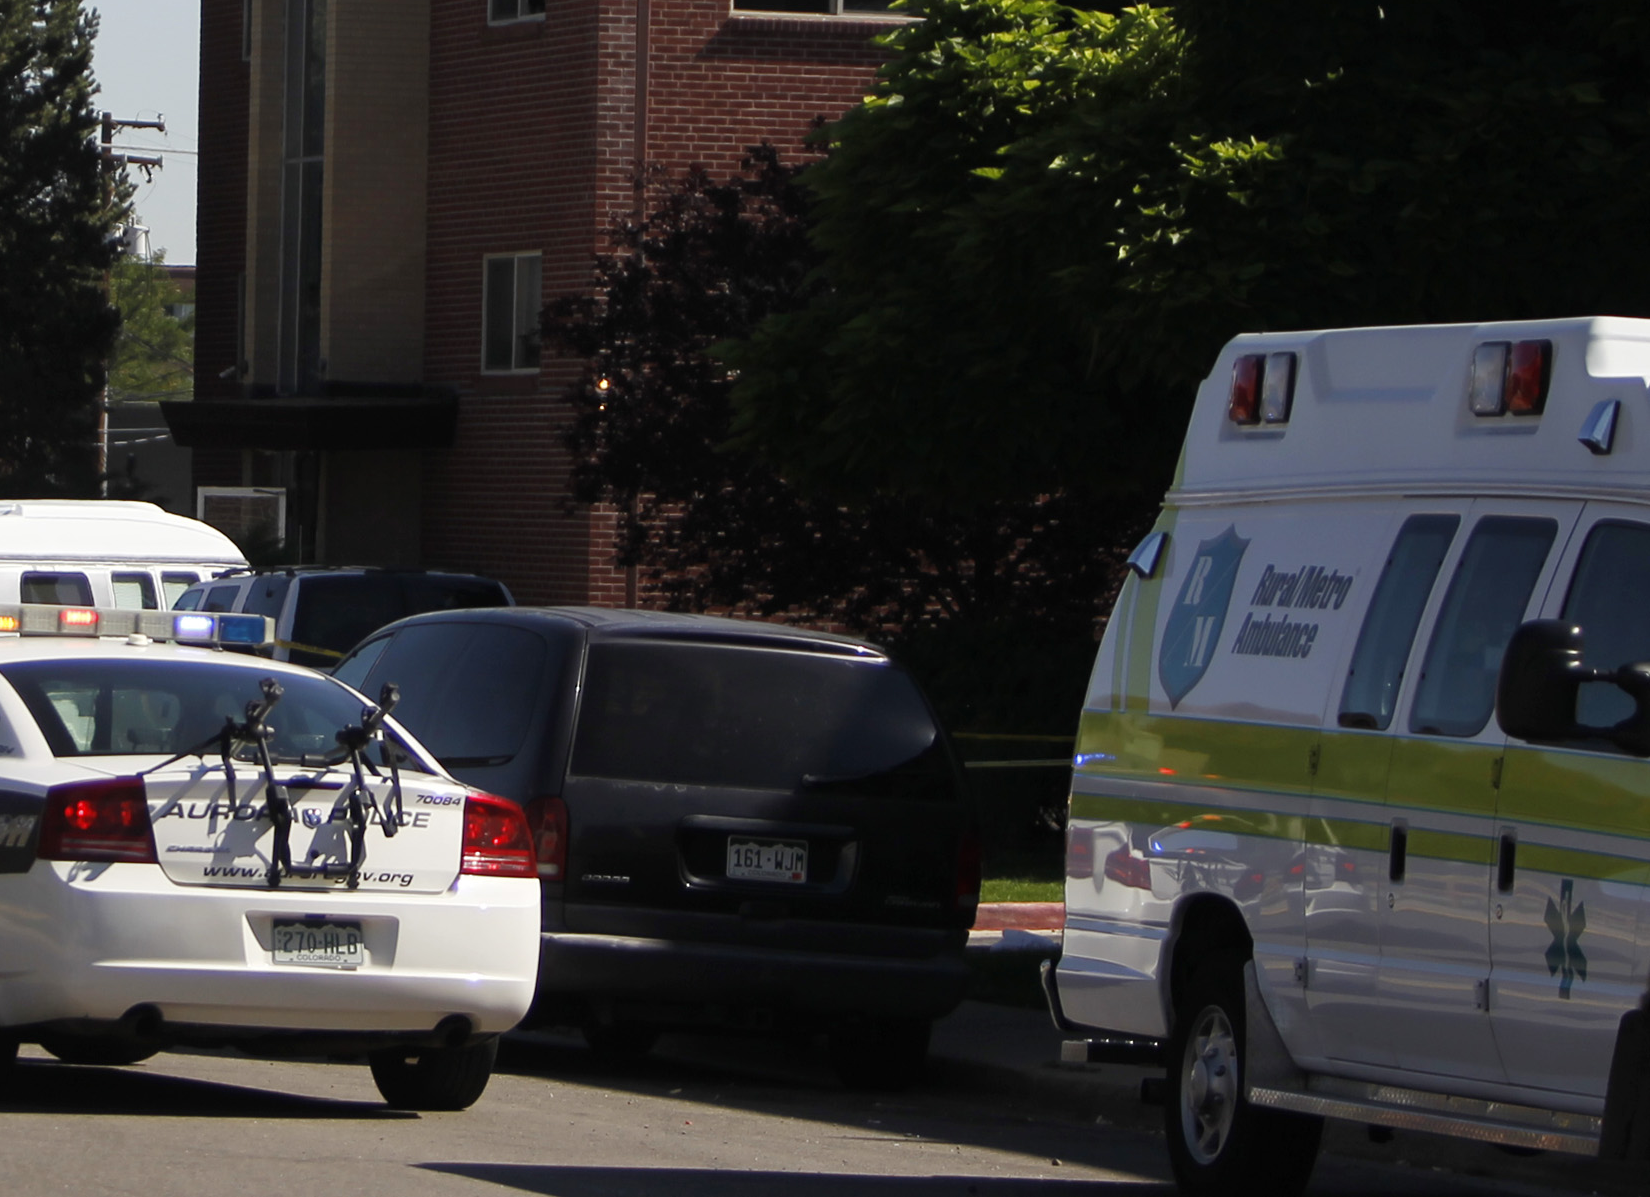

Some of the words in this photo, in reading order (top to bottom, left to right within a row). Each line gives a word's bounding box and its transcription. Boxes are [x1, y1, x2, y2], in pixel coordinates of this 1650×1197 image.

[1183, 556, 1213, 605] R
[1250, 564, 1353, 611] Rural/Metro
[1183, 615, 1216, 667] M
[1231, 611, 1319, 659] Ambulance
[415, 794, 462, 806] 70084
[296, 954, 341, 962] COLORADO
